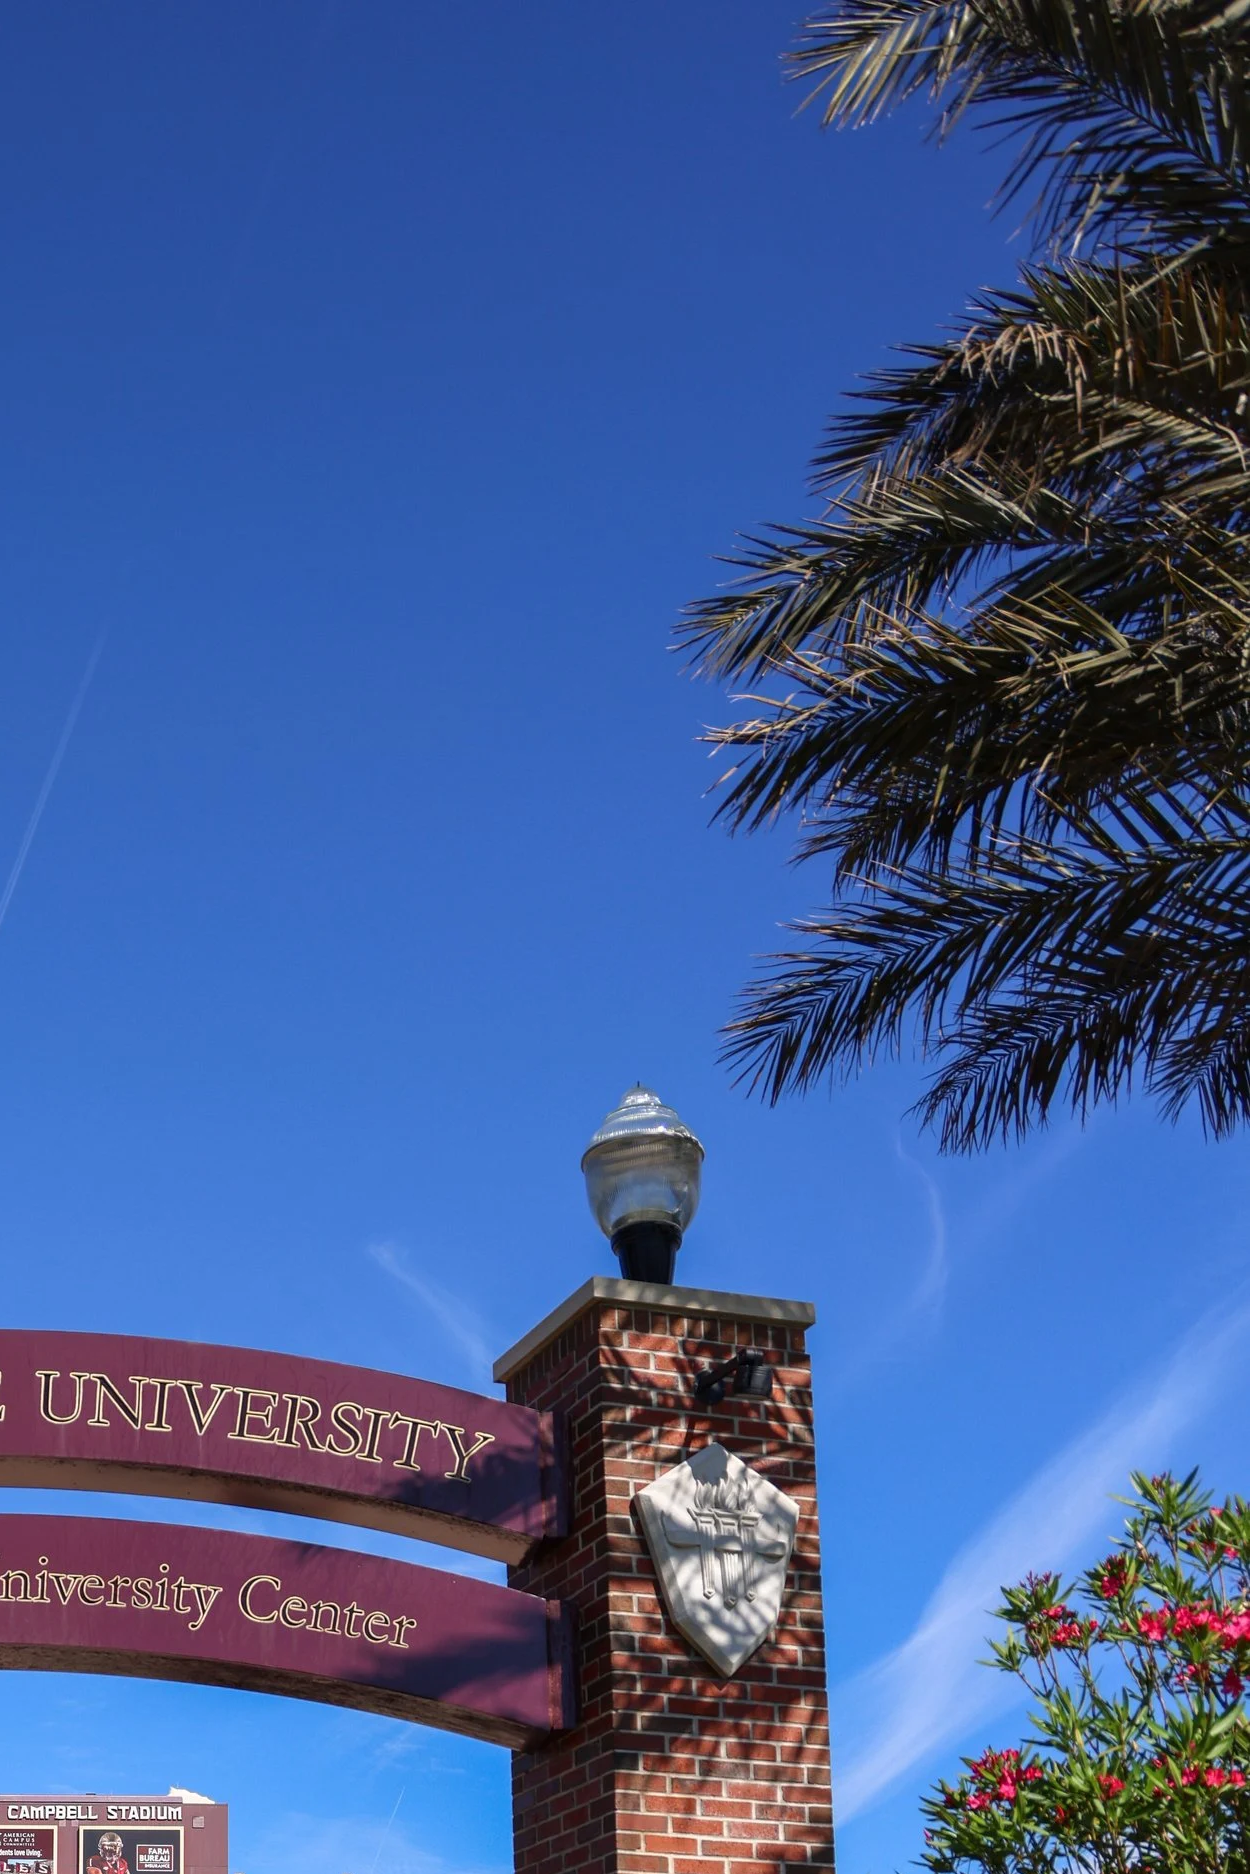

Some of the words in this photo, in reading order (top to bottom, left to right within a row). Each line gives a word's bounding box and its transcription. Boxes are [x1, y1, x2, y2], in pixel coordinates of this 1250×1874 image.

[35, 1370, 495, 1483] UNIVERSITY
[238, 1574, 418, 1649] Center
[7, 1805, 99, 1820] CAMPBELL
[107, 1805, 183, 1821] STADIUM
[14, 1848, 26, 1856] love
[148, 1847, 170, 1855] FARM
[138, 1854, 170, 1862] BUREAU
